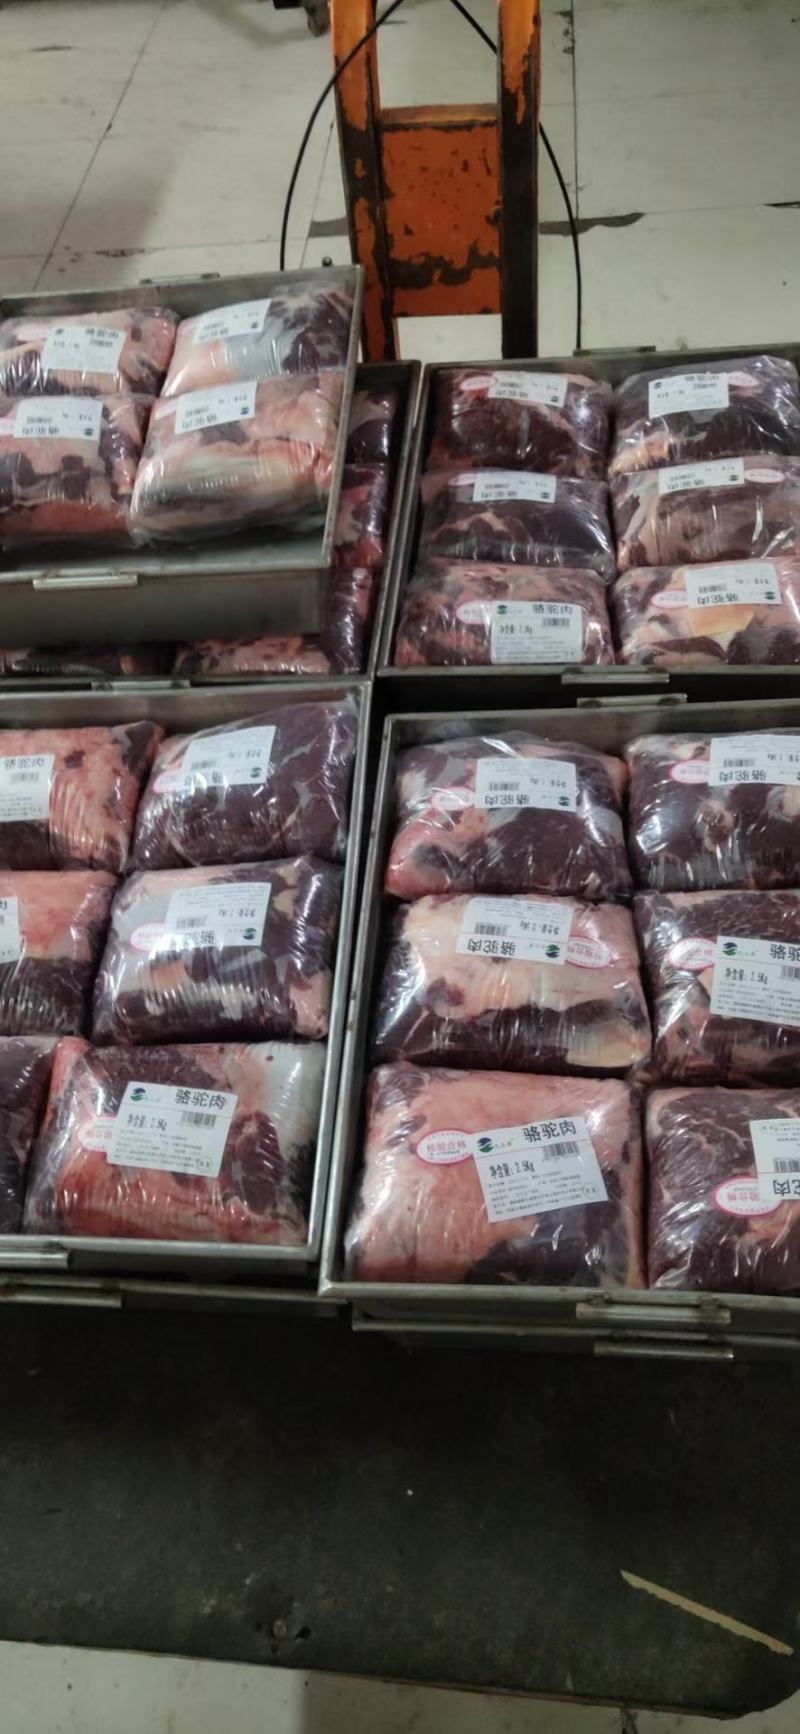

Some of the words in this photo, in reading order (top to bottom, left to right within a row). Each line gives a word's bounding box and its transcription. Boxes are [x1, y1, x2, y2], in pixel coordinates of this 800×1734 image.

[719, 769, 767, 782] 骆驼肉
[485, 793, 530, 807] 骆驼肉
[467, 938, 516, 956] 骆驼肉
[174, 1088, 226, 1110] 骆驼肉
[522, 1119, 577, 1143] 骆驼肉
